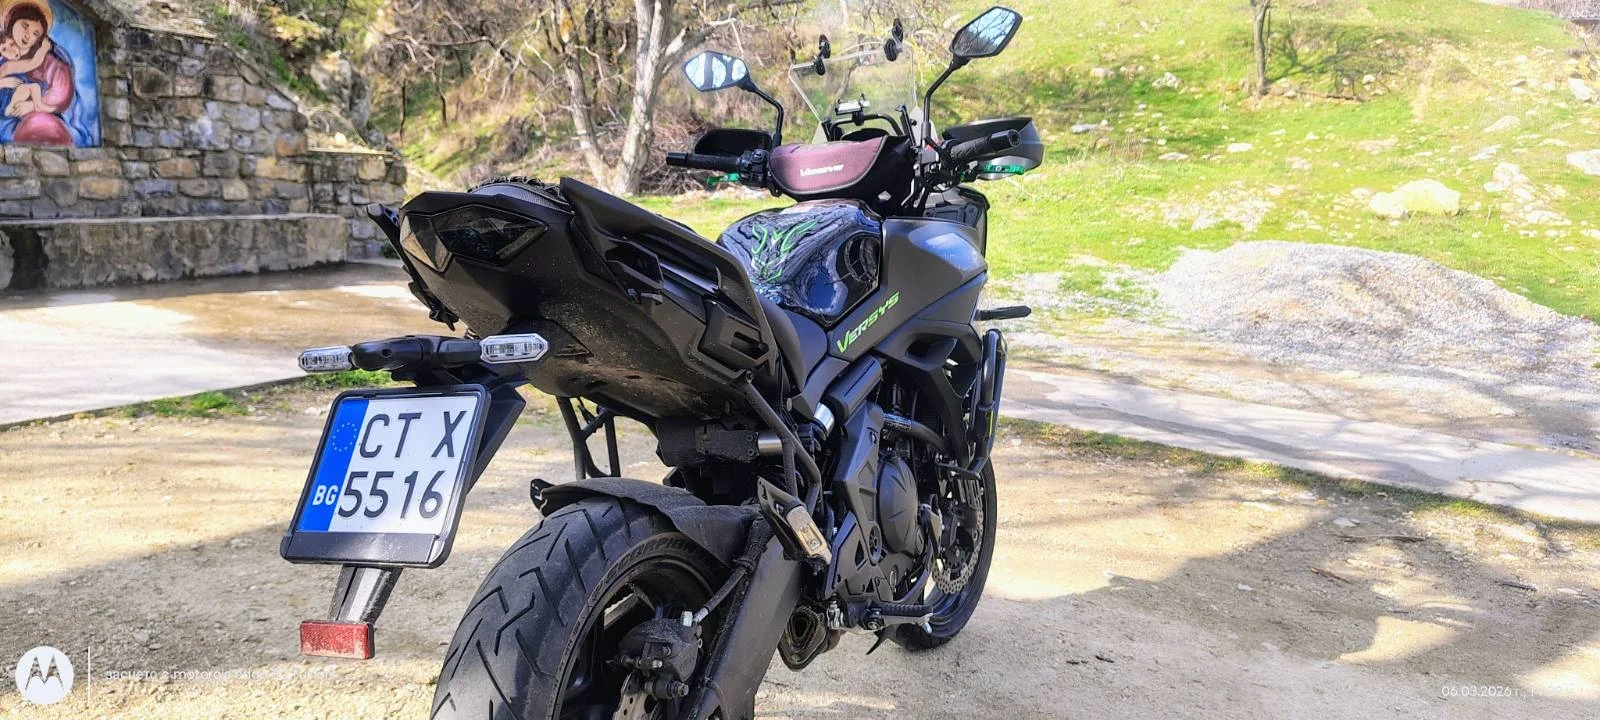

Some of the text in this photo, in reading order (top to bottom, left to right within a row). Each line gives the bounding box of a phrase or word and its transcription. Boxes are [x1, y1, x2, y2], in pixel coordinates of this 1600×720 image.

[836, 291, 900, 353] VERSYS
[359, 411, 468, 458] CT X
[312, 485, 339, 506] BG
[338, 470, 446, 519] 5516
